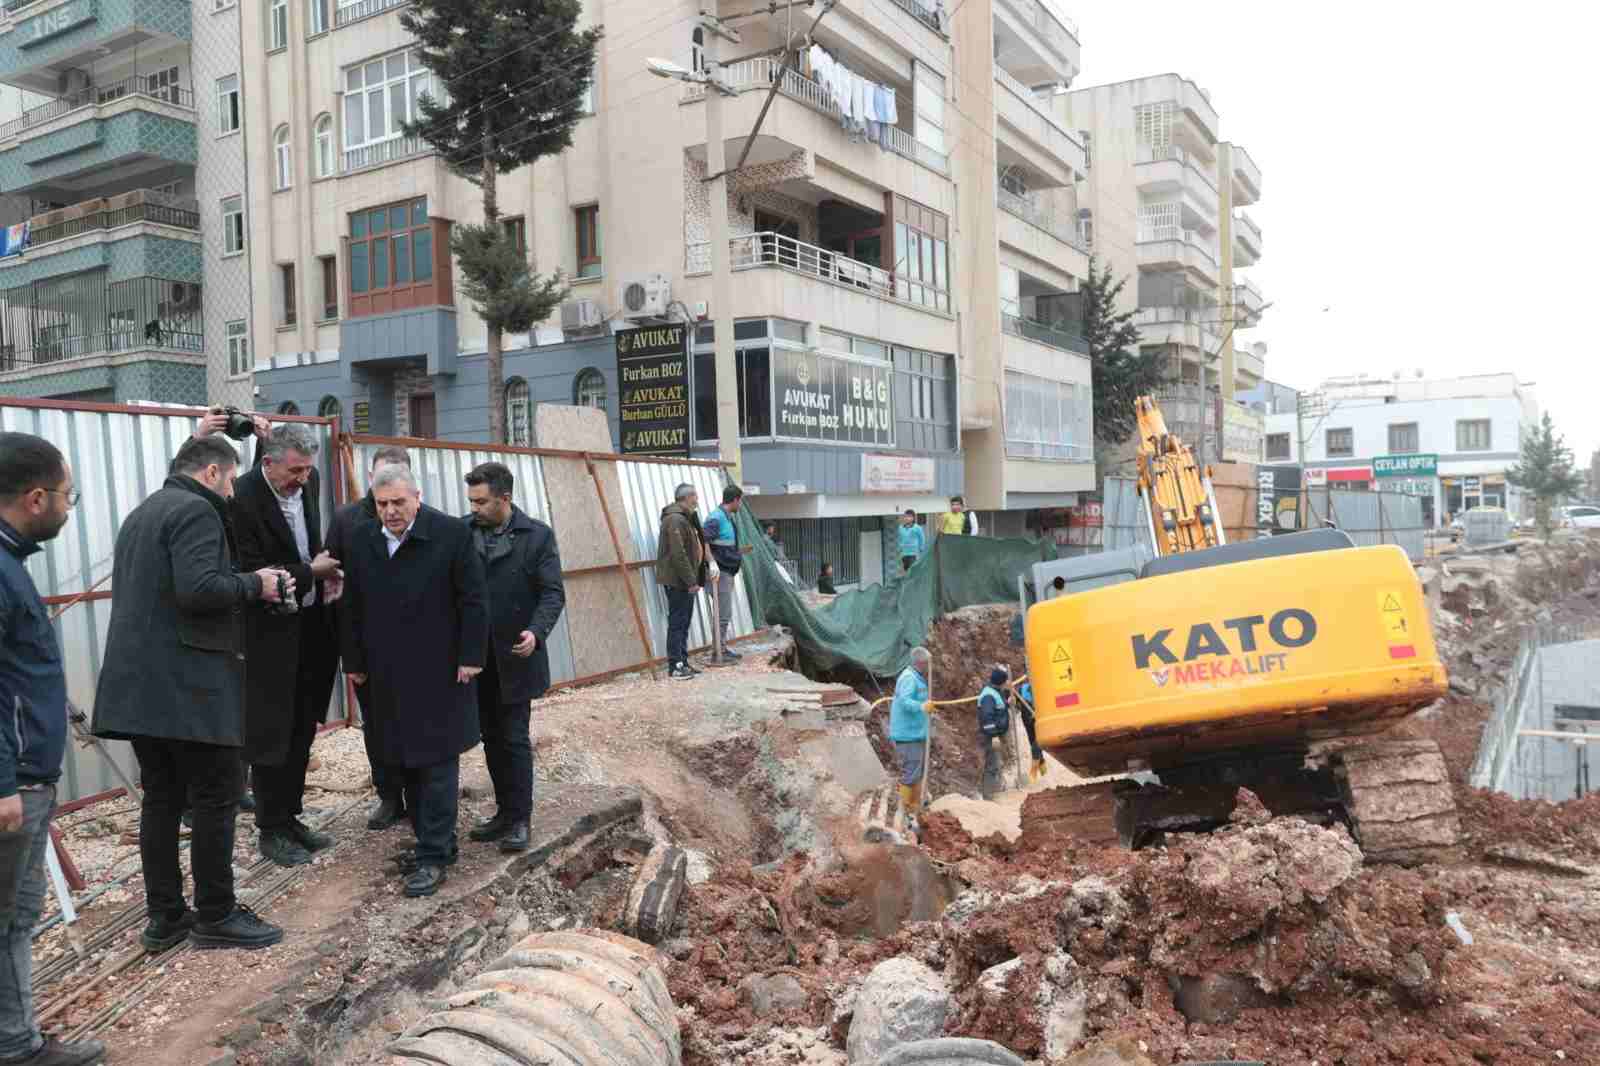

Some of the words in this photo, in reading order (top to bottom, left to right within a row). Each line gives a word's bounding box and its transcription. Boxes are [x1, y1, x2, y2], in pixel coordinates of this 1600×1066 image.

[633, 328, 682, 349] AVUKAT
[624, 365, 659, 381] Furkan
[661, 362, 682, 377] BOZ
[633, 385, 683, 402] AVUKAT
[784, 389, 831, 410] AVUKAT
[655, 402, 686, 417] GÜLLÜ
[782, 409, 817, 427] Furkan
[819, 414, 840, 429] BOZ
[636, 428, 686, 447] AVUKAT
[1258, 471, 1274, 523] RELAX
[1131, 608, 1317, 669] KATO
[1173, 653, 1288, 685] MEKALIFT
